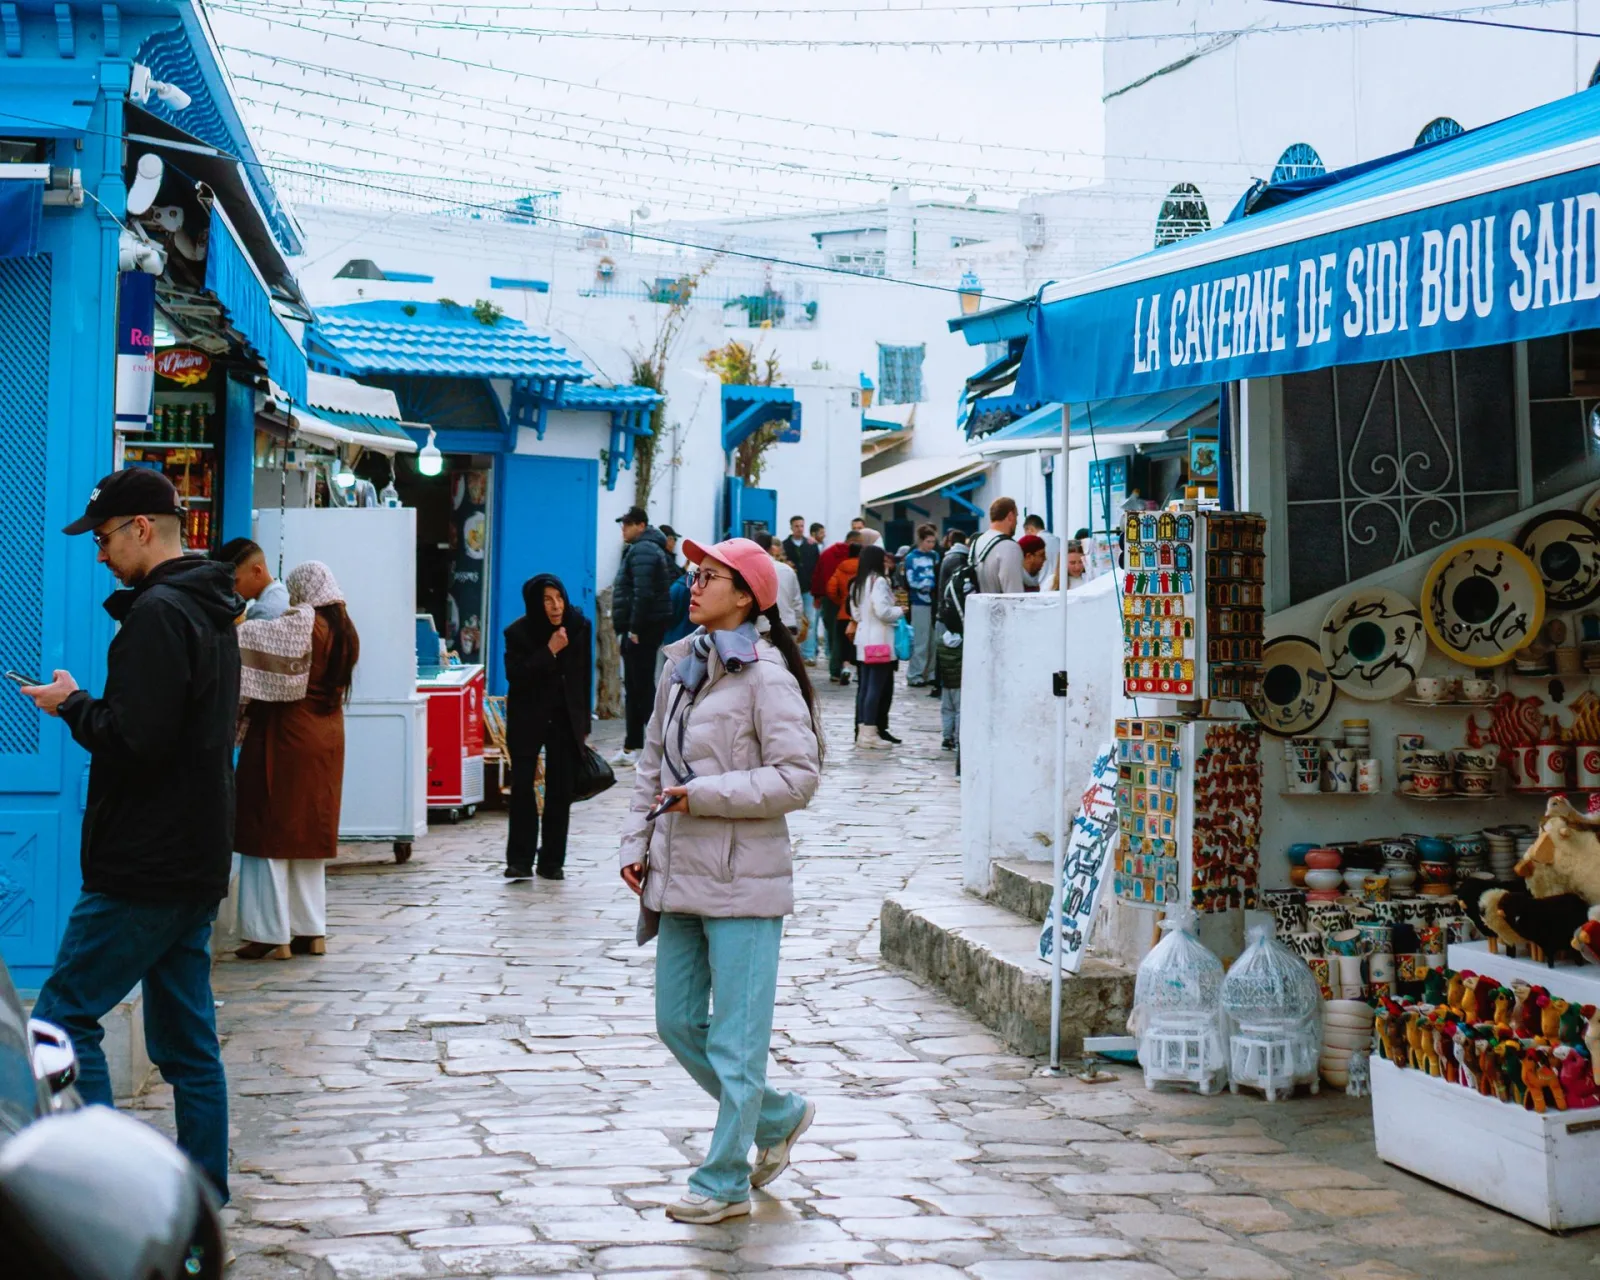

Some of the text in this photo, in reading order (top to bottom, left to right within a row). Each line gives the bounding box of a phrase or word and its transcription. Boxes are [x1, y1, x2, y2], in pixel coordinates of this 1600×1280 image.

[1133, 191, 1600, 374] LA CAVERNE DE SIDI BOU SAID
